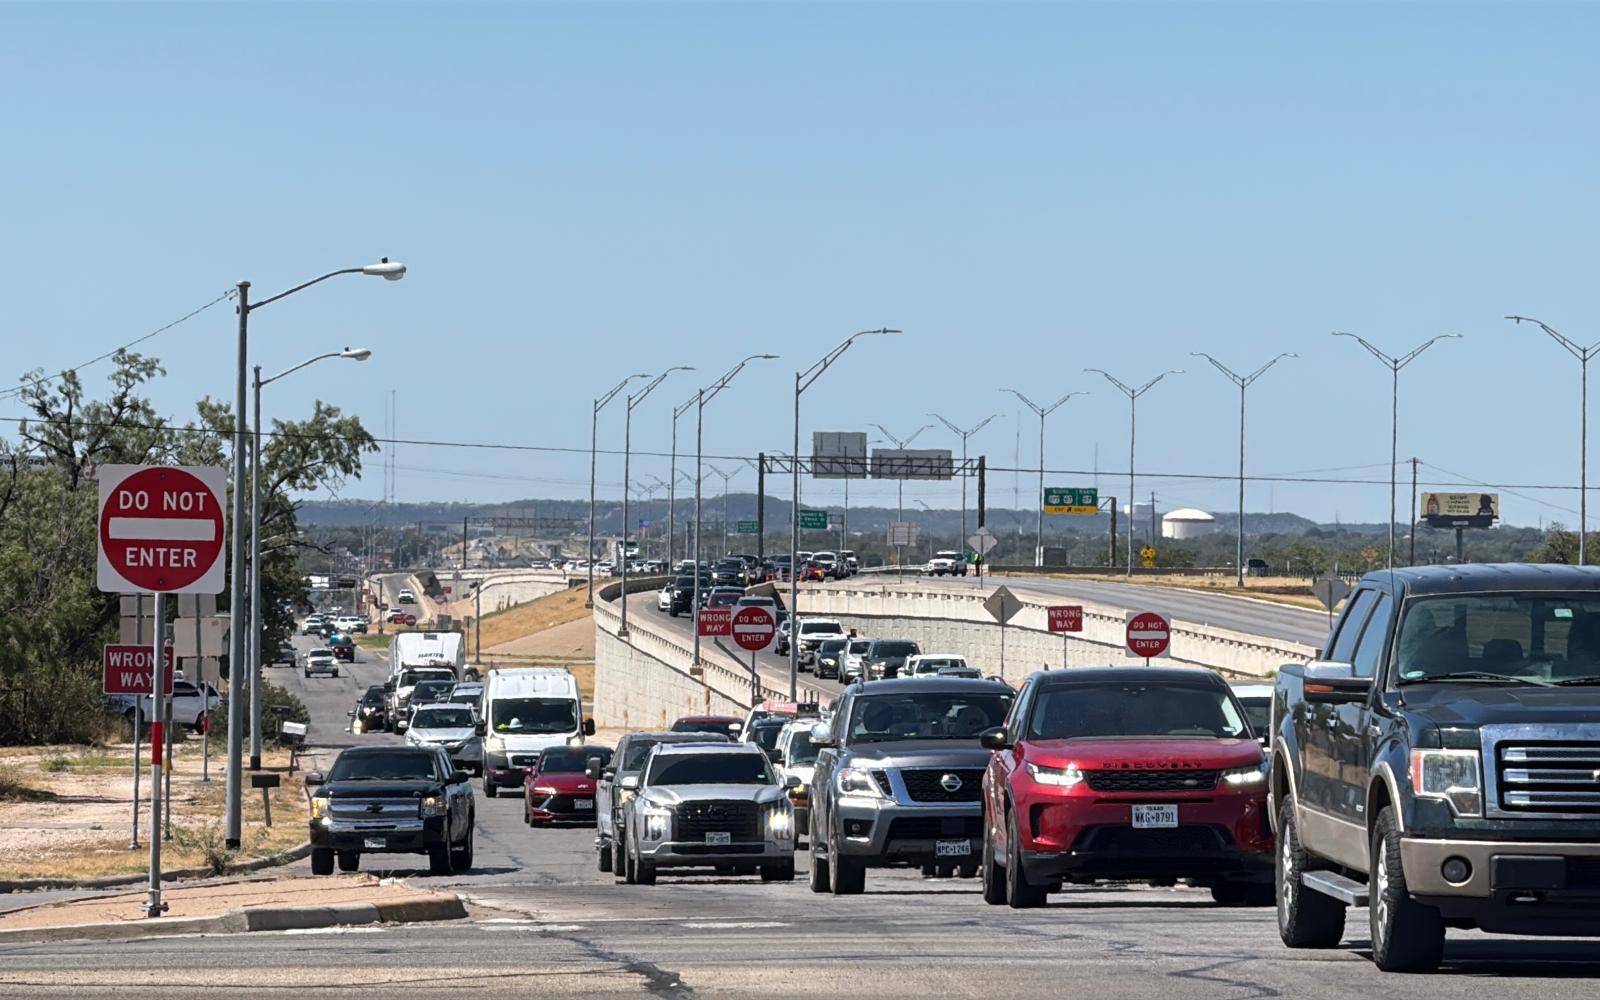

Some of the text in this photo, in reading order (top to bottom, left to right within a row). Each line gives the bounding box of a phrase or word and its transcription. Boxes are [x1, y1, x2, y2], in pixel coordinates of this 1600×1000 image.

[119, 490, 208, 511] DO NOT
[125, 547, 197, 568] ENTER
[700, 613, 731, 622] WRONG
[1049, 610, 1081, 618] WRONG
[738, 615, 768, 623] DO NOT
[706, 624, 725, 633] WAY
[1056, 620, 1075, 628] WAY
[742, 634, 765, 642] ENTER
[109, 652, 170, 668] WRONG
[120, 672, 155, 687] WAY
